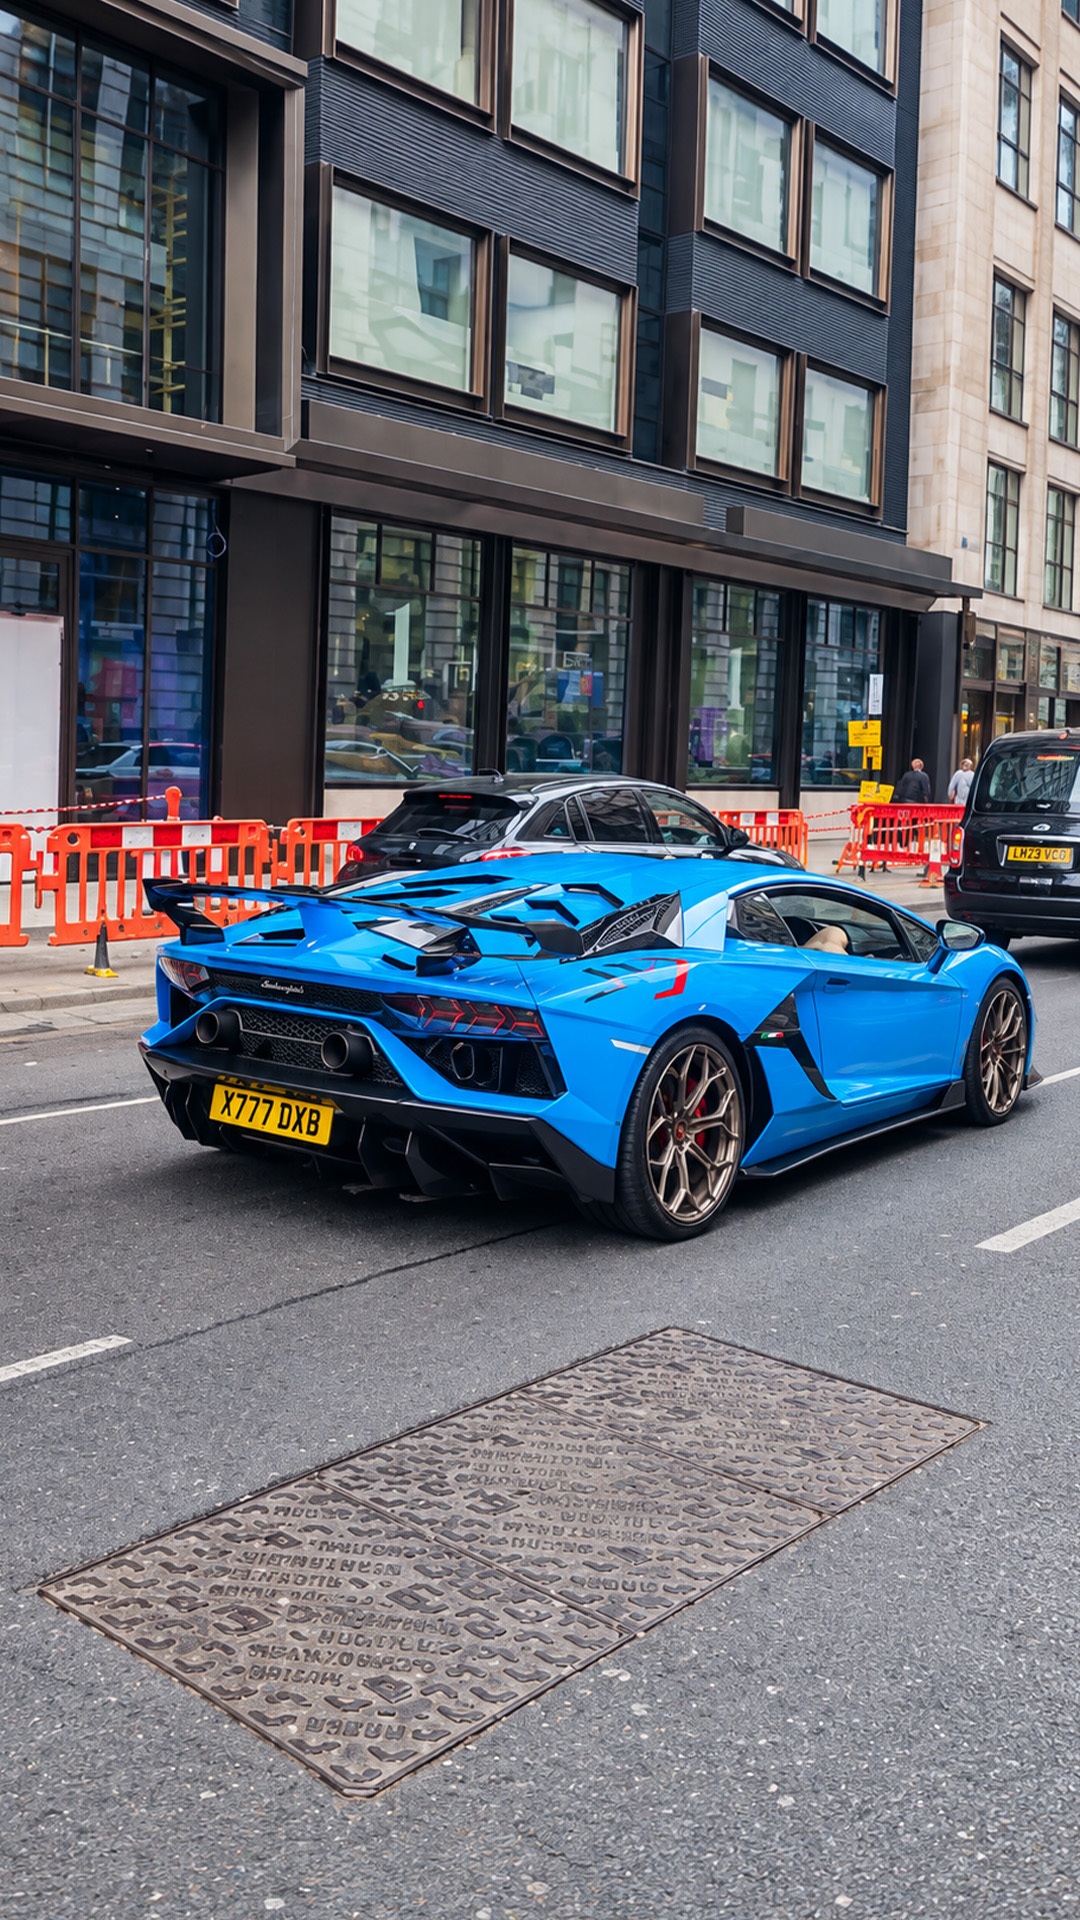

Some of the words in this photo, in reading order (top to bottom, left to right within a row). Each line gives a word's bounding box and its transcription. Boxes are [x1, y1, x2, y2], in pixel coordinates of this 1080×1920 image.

[1013, 848, 1041, 859] LH23
[221, 1090, 274, 1126] X777
[278, 1102, 320, 1136] DXB
